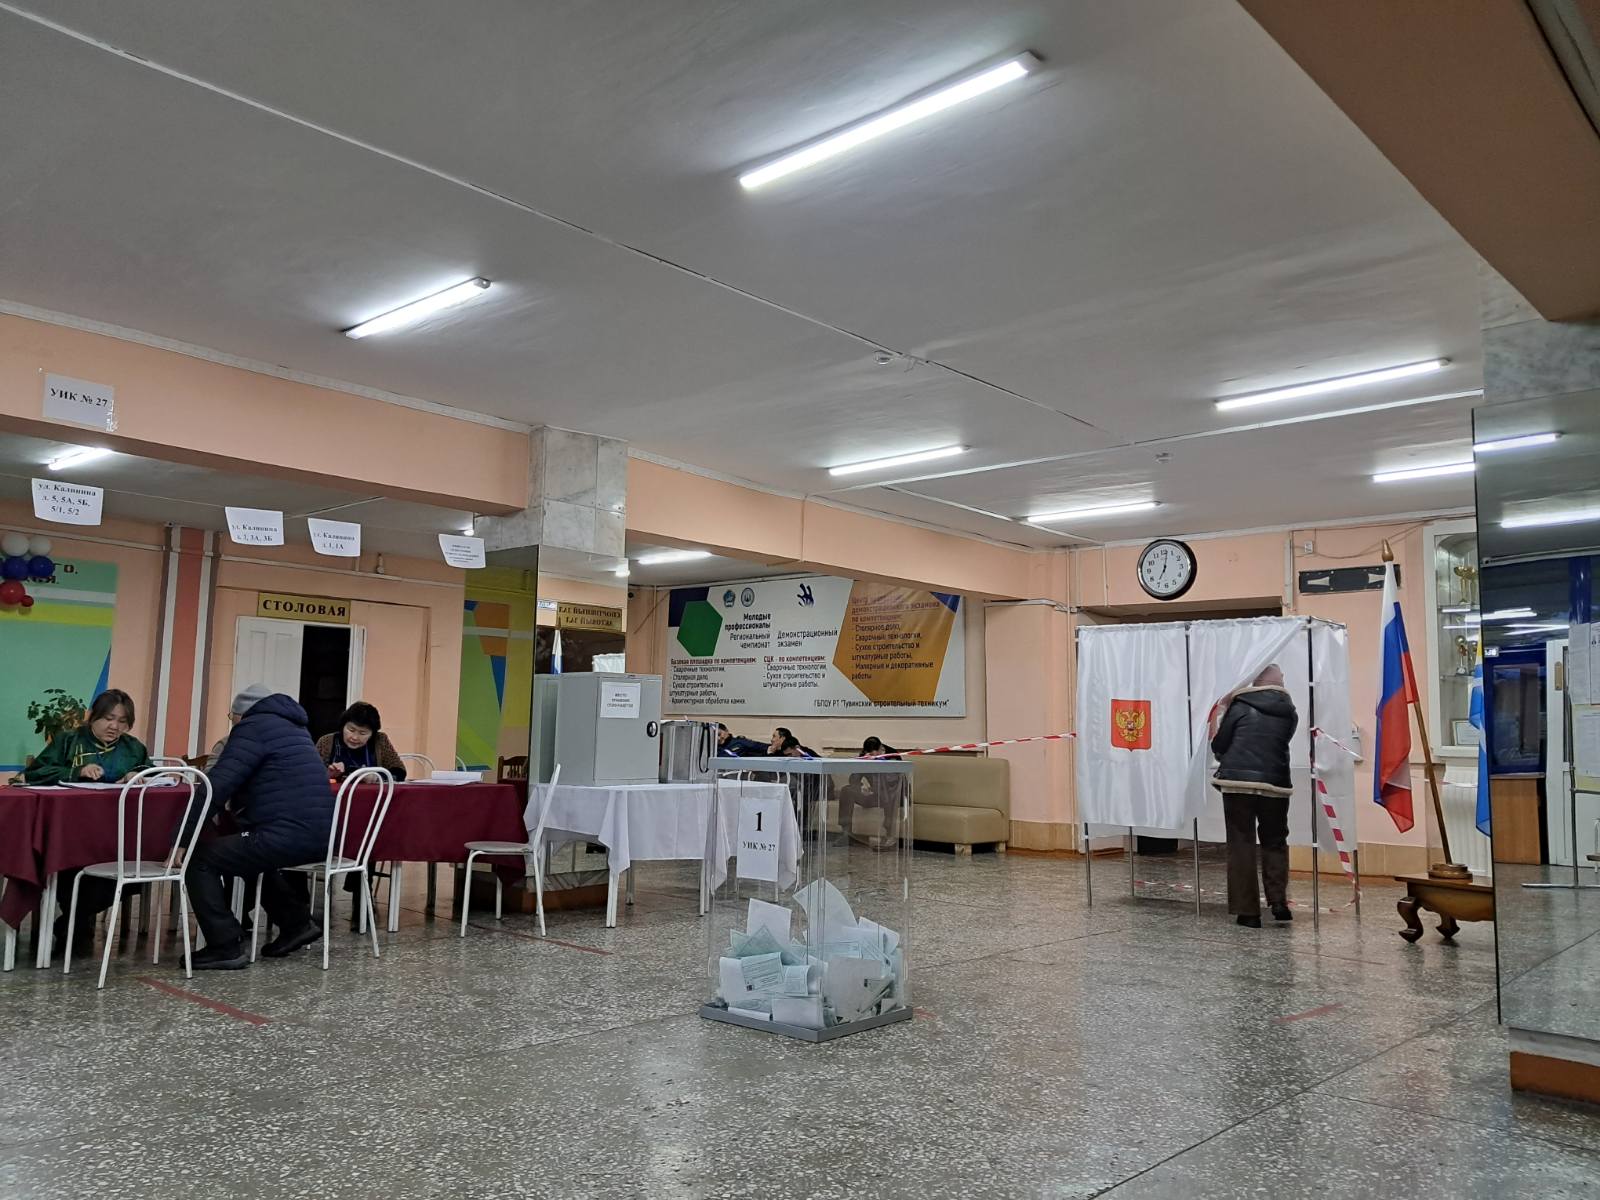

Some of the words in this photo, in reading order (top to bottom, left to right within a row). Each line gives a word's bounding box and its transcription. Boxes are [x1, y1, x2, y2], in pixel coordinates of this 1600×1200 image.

[50, 388, 78, 401] УИК
[80, 394, 93, 405] №
[95, 397, 108, 407] 27
[54, 484, 96, 497] Калинина
[67, 507, 80, 516] 5/2
[262, 599, 346, 617] СТОЛОВАЯ
[743, 613, 772, 621] Молодые
[725, 622, 771, 632] профессионалы
[730, 630, 771, 641] Региональный
[777, 627, 838, 640] Демонстрационный
[740, 641, 770, 649] чемпионат
[777, 640, 802, 648] экзамен
[832, 699, 840, 707] РТ
[755, 812, 763, 832] 1
[743, 841, 758, 850] УИК
[768, 844, 776, 852] 27
